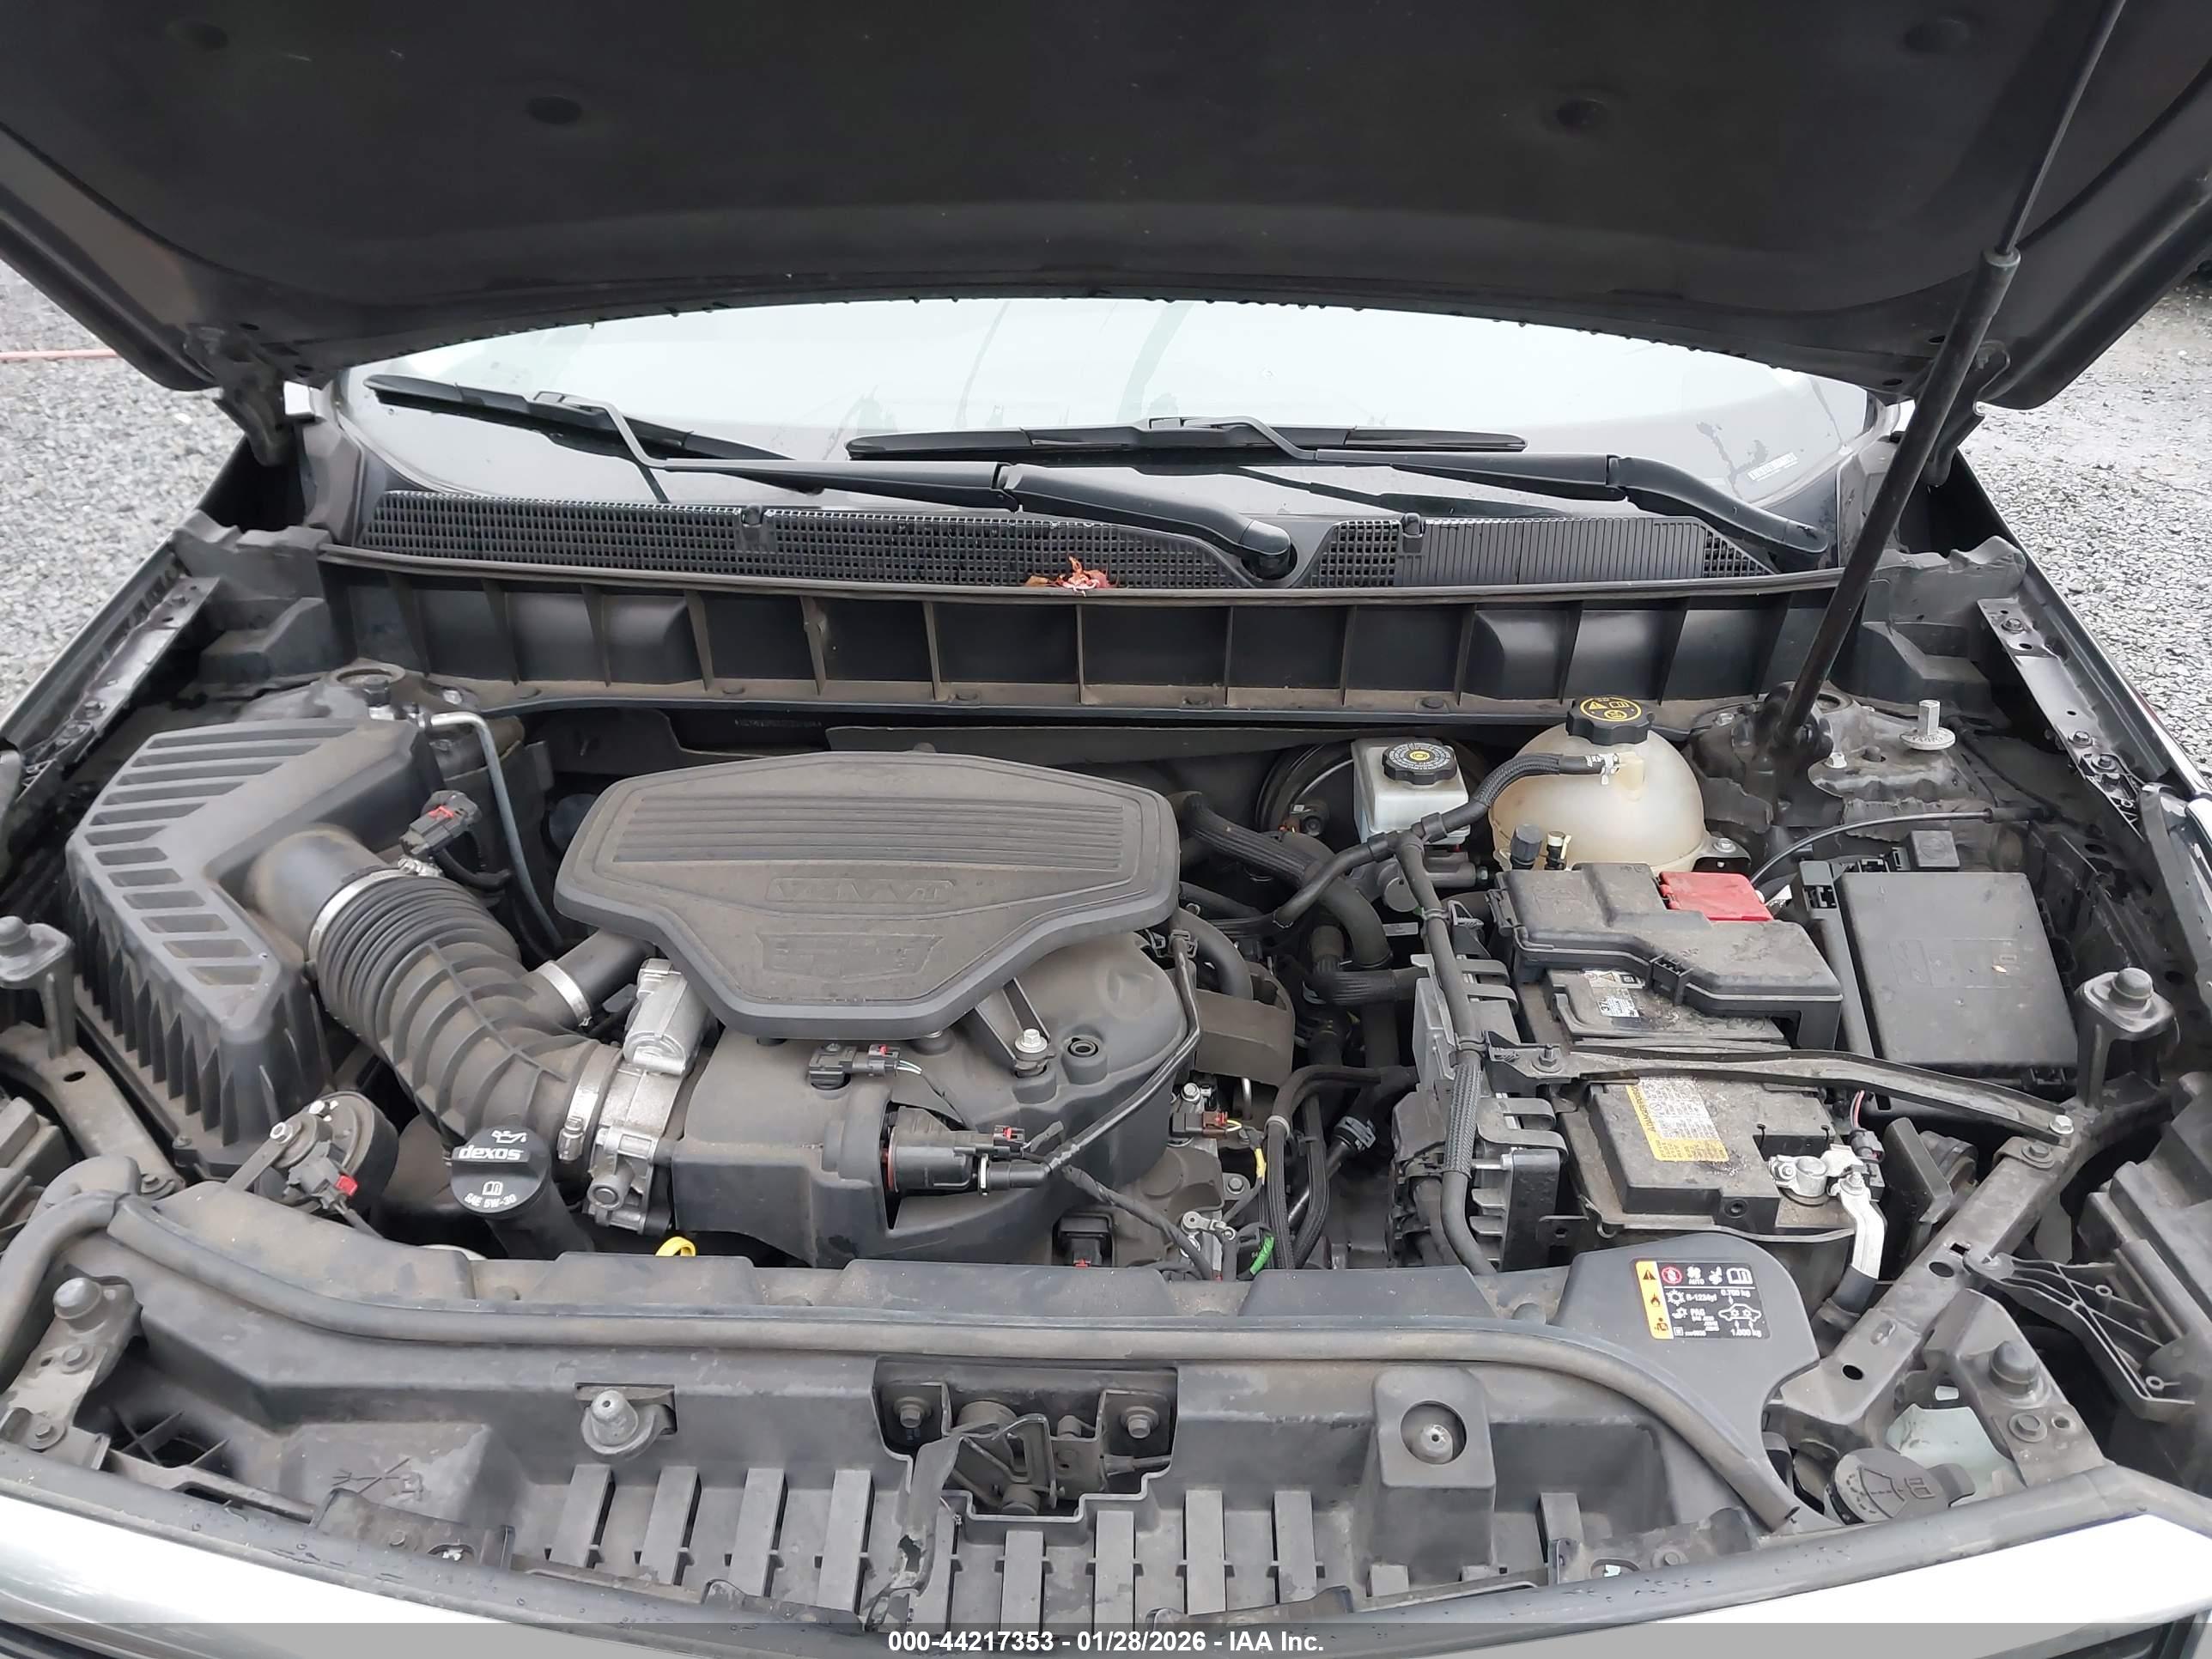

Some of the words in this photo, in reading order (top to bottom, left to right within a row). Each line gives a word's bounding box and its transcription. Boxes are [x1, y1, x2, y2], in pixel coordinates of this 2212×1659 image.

[459, 1145, 524, 1159] dexos
[465, 1193, 483, 1207] SAE
[483, 1194, 517, 1208] 5W-30
